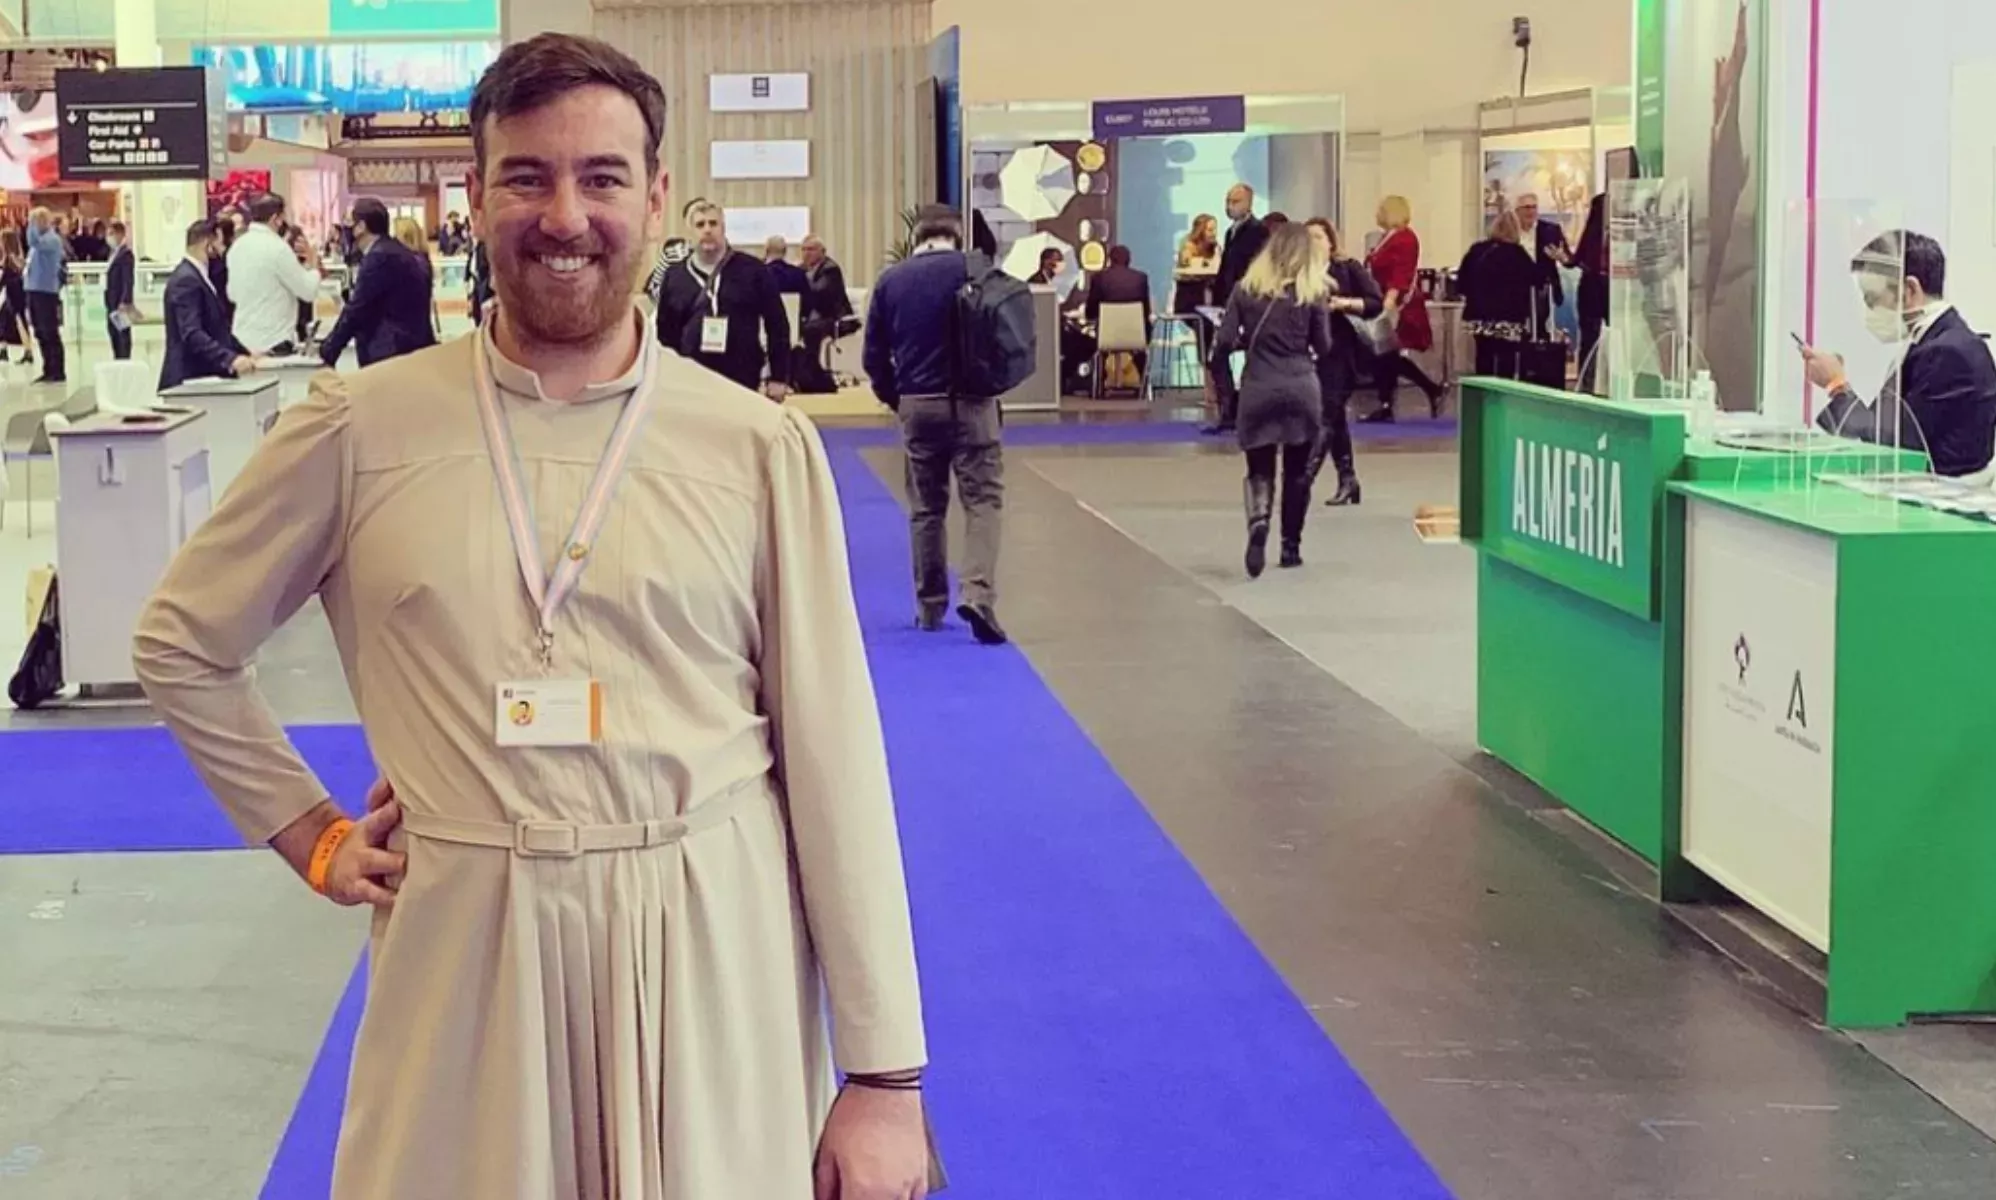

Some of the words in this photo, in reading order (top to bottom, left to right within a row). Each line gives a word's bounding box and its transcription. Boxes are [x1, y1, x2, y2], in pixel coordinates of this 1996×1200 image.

[113, 125, 129, 136] Aid
[88, 139, 107, 150] Car
[108, 139, 137, 150] Parks
[1512, 432, 1623, 568] ALMERÍA
